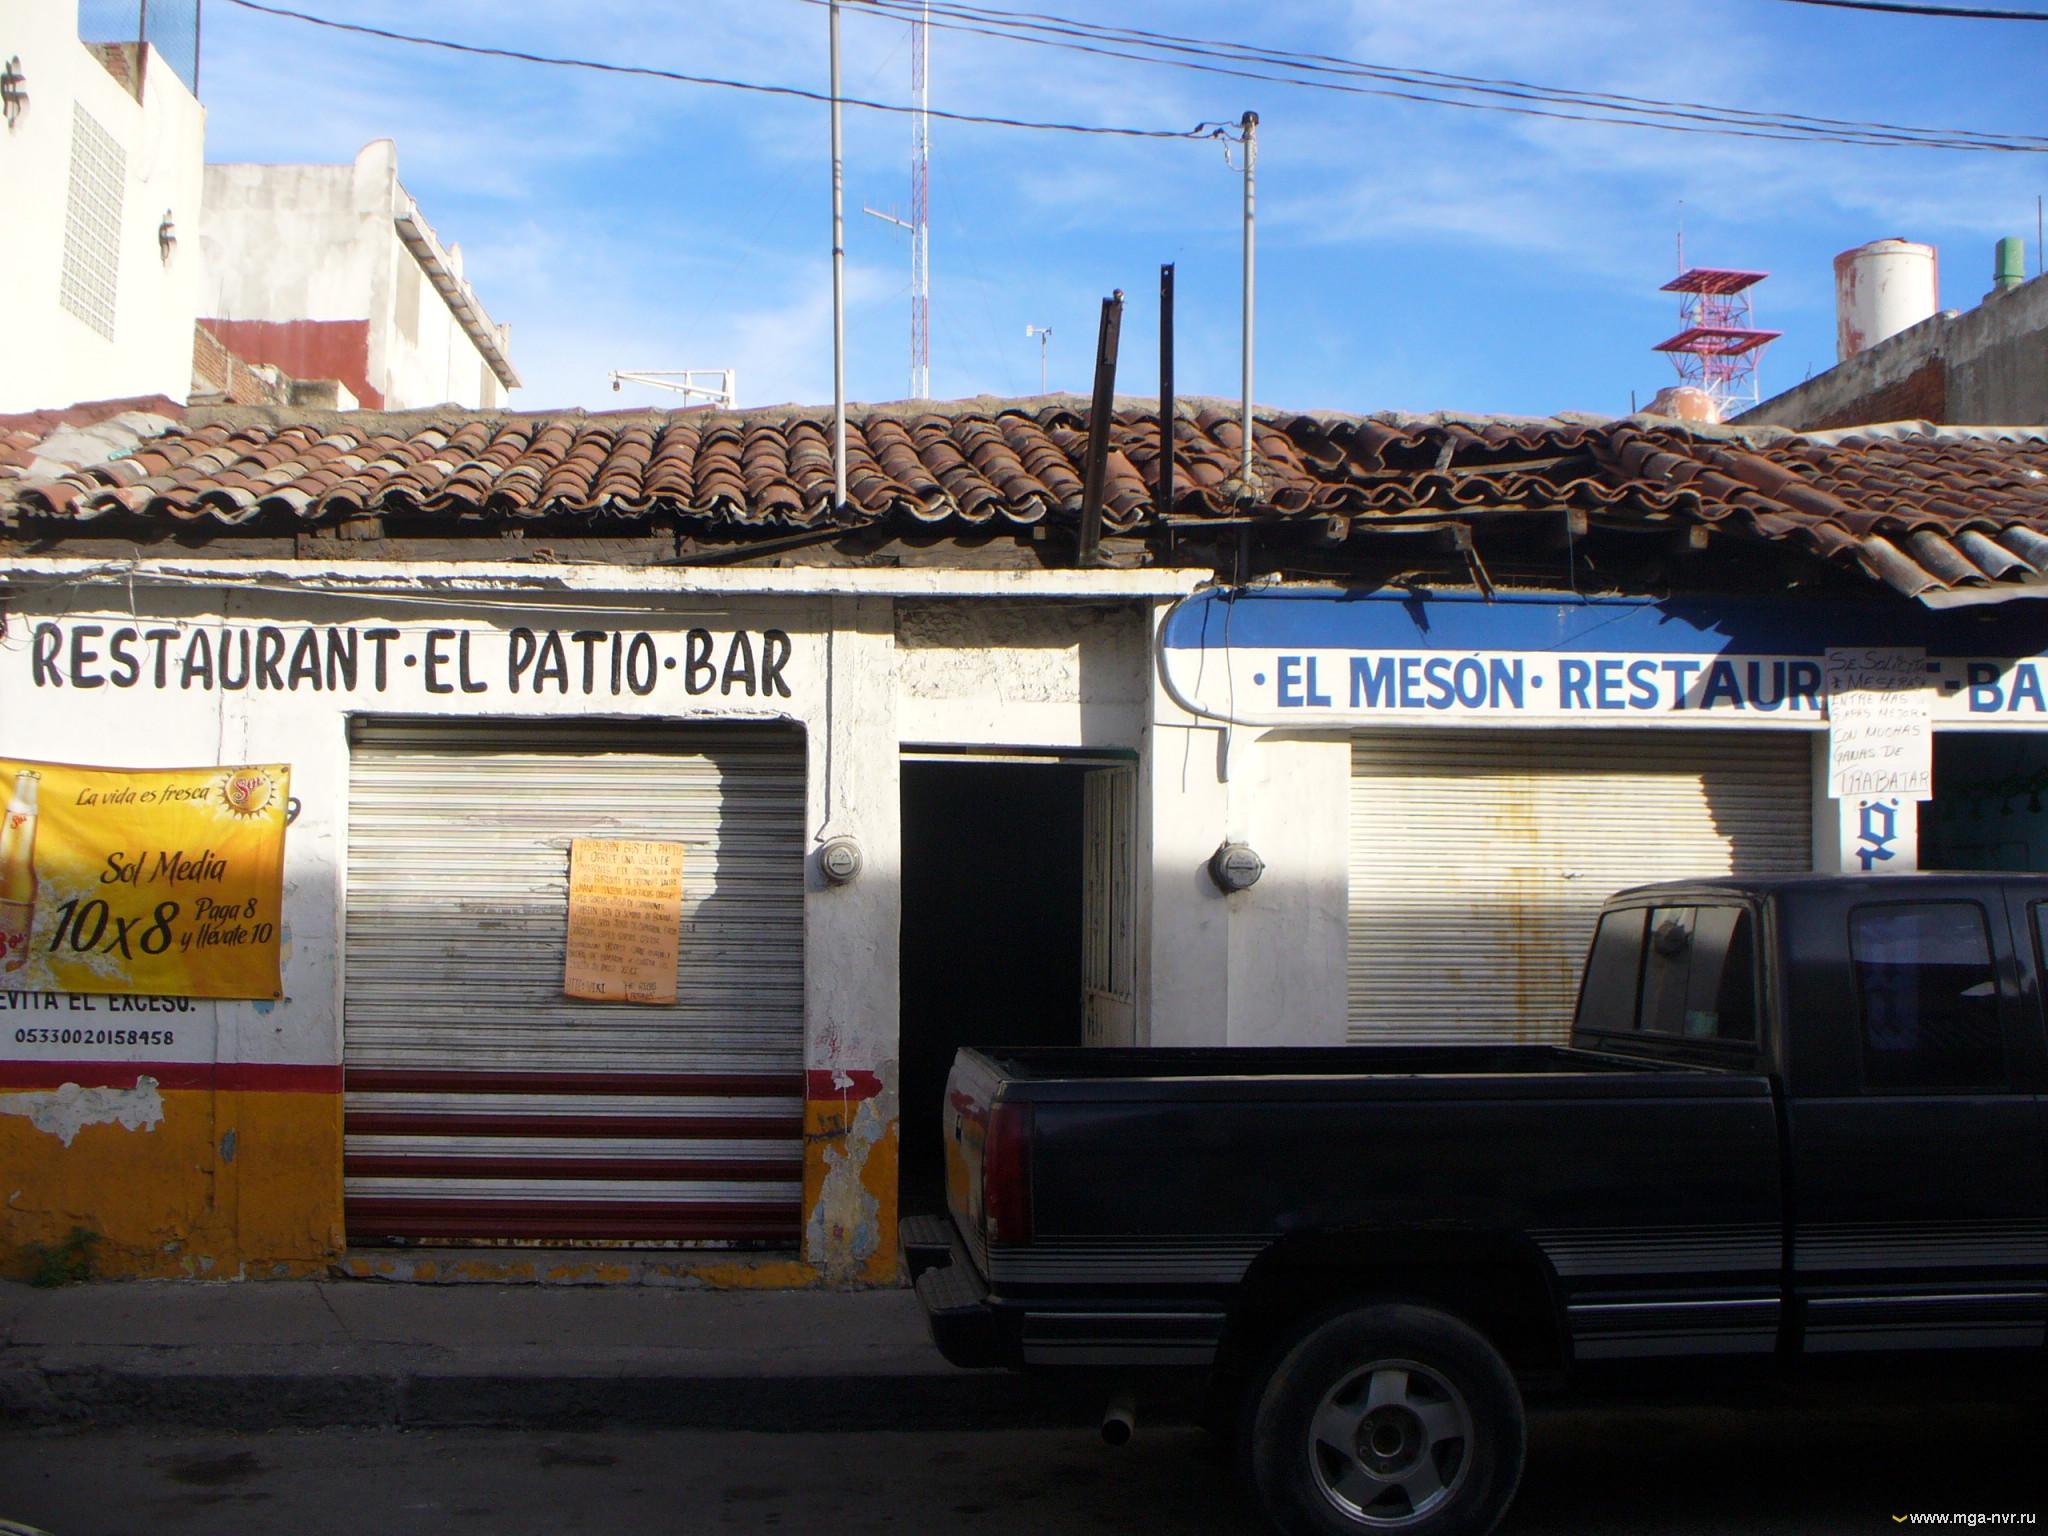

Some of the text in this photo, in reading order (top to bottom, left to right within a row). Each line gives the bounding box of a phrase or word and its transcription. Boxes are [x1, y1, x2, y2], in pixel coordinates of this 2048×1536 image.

[32, 622, 792, 698] RESTAURANT EL PATIO BAR
[1277, 652, 1524, 710] EL MESÓN
[76, 784, 210, 806] La vida es fresca
[100, 849, 228, 888] Sol Media
[195, 897, 258, 927] Paga 8
[181, 921, 273, 953] y llévate 10
